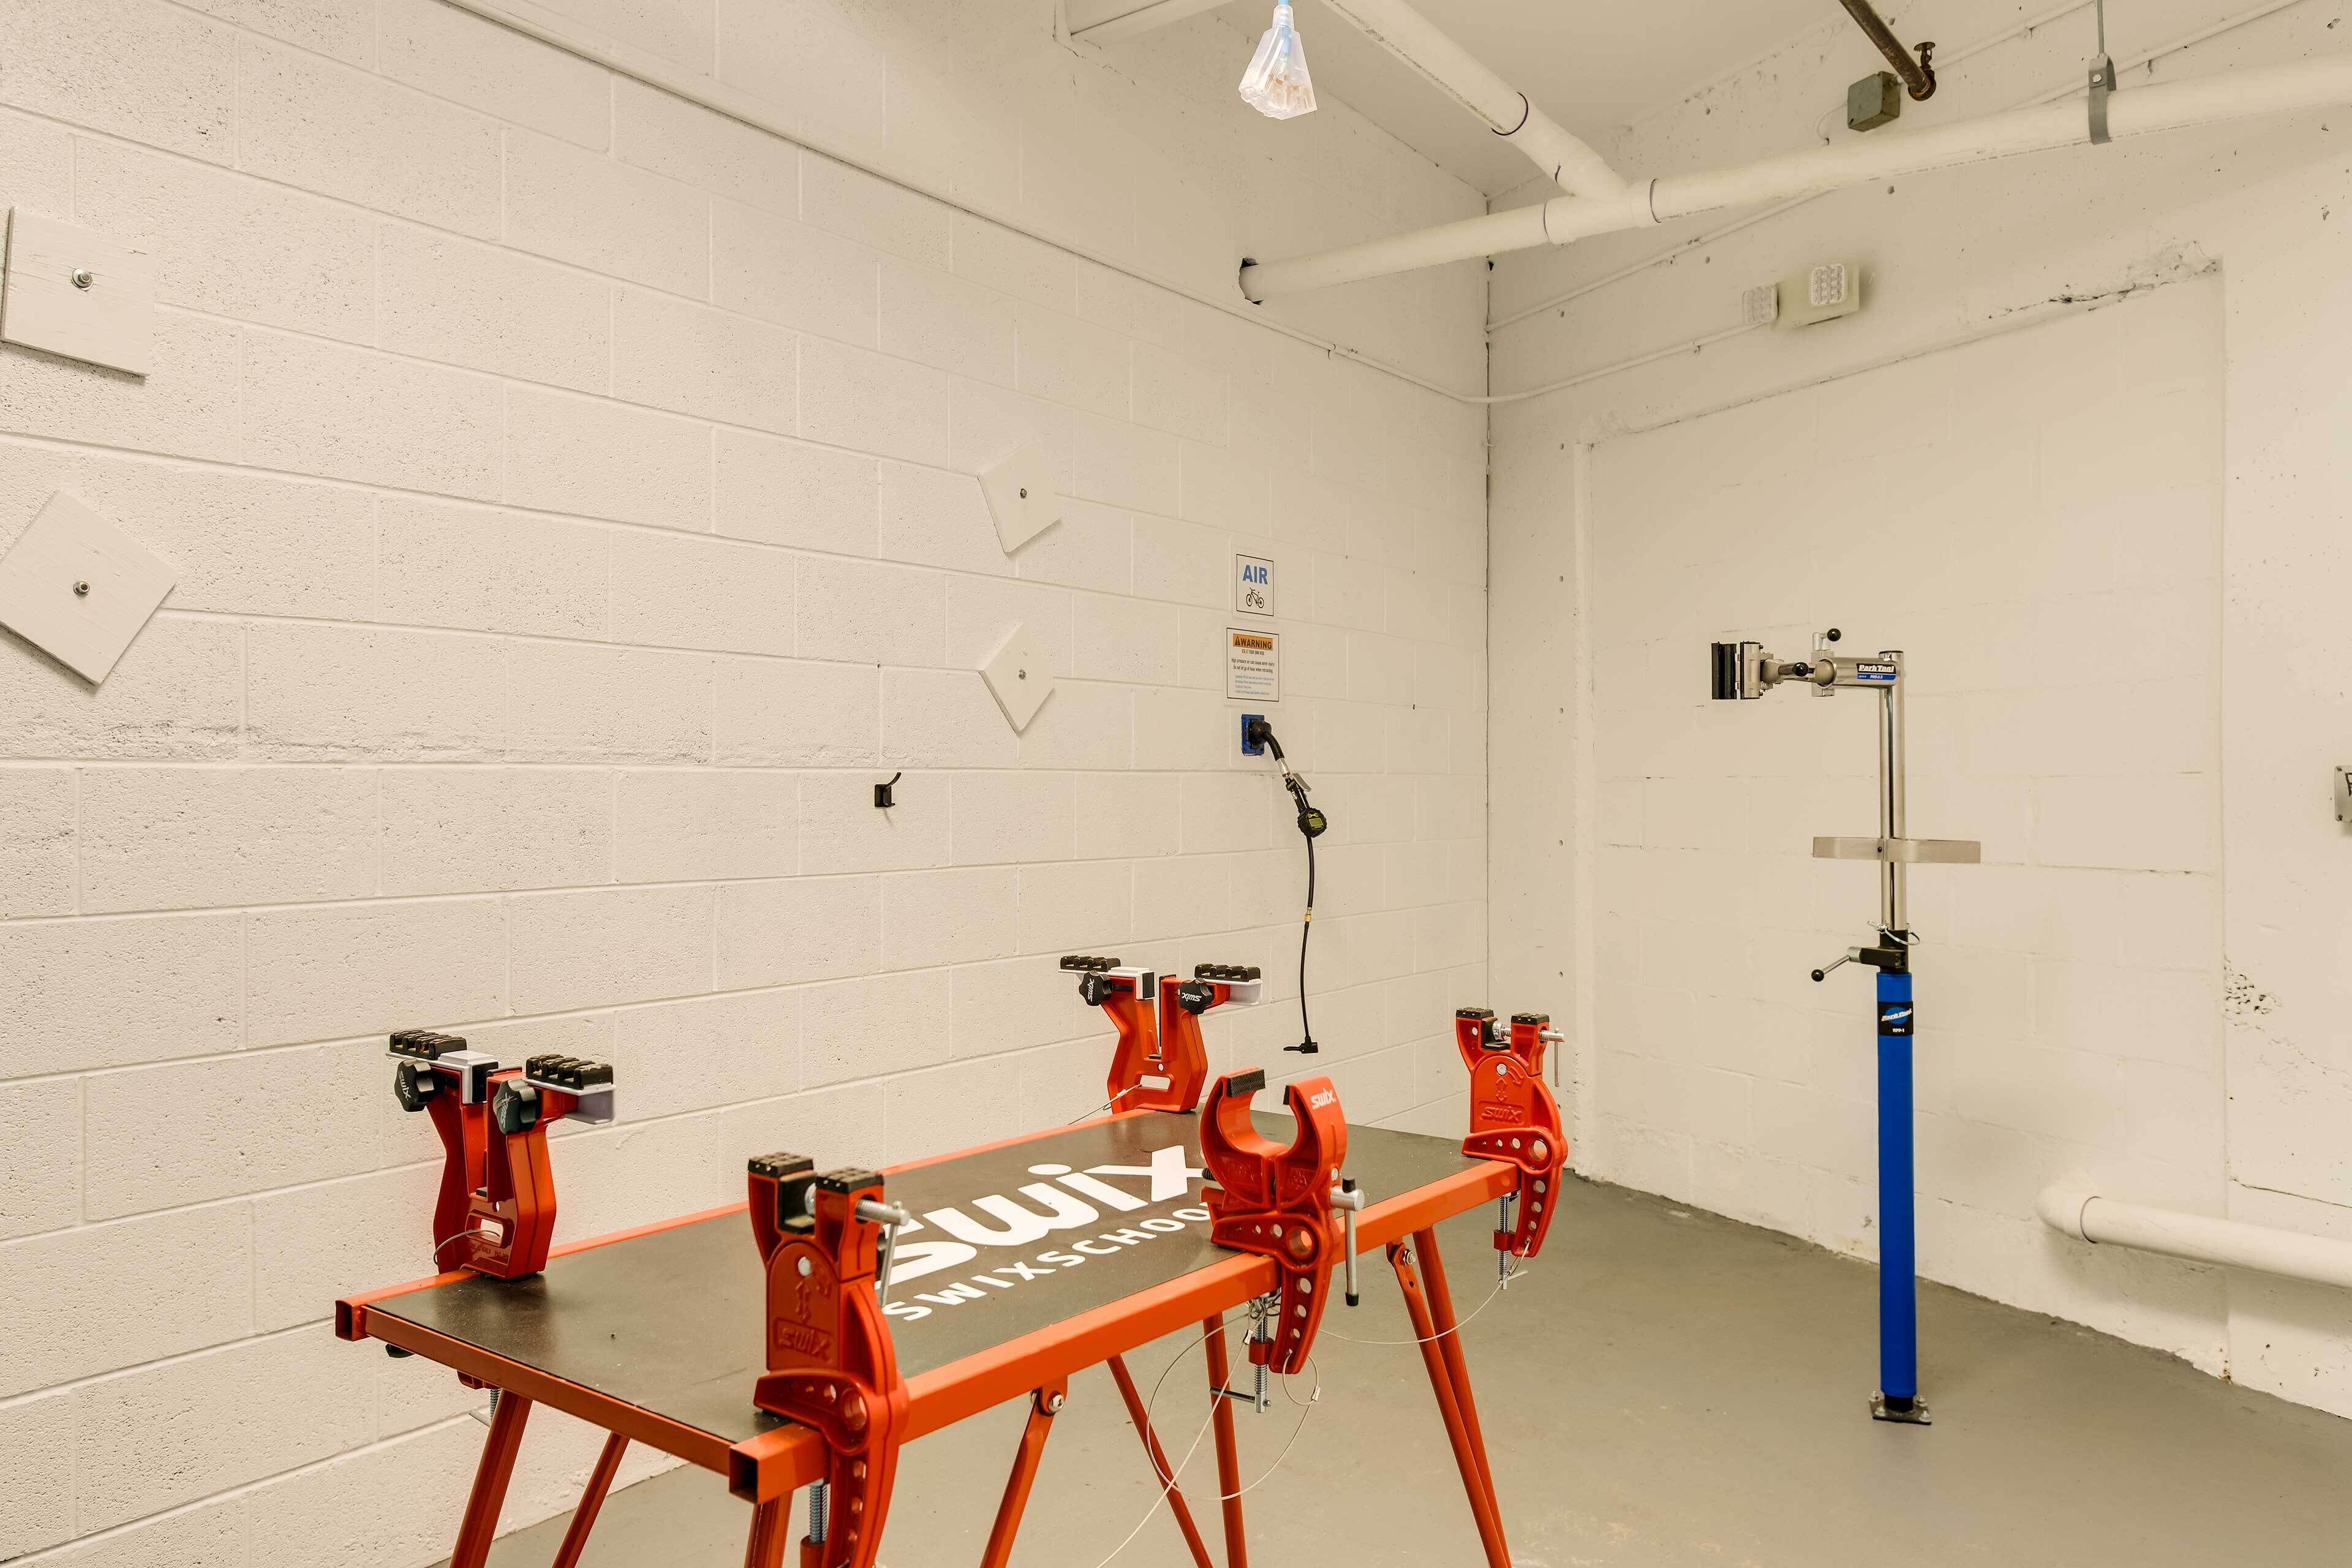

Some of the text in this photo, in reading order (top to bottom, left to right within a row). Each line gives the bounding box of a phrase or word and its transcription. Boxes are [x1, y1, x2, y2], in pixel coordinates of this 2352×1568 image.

[1242, 564, 1268, 585] AIR
[1240, 638, 1272, 649] WARNING
[881, 1202, 1211, 1321] SWIXSCHOO
